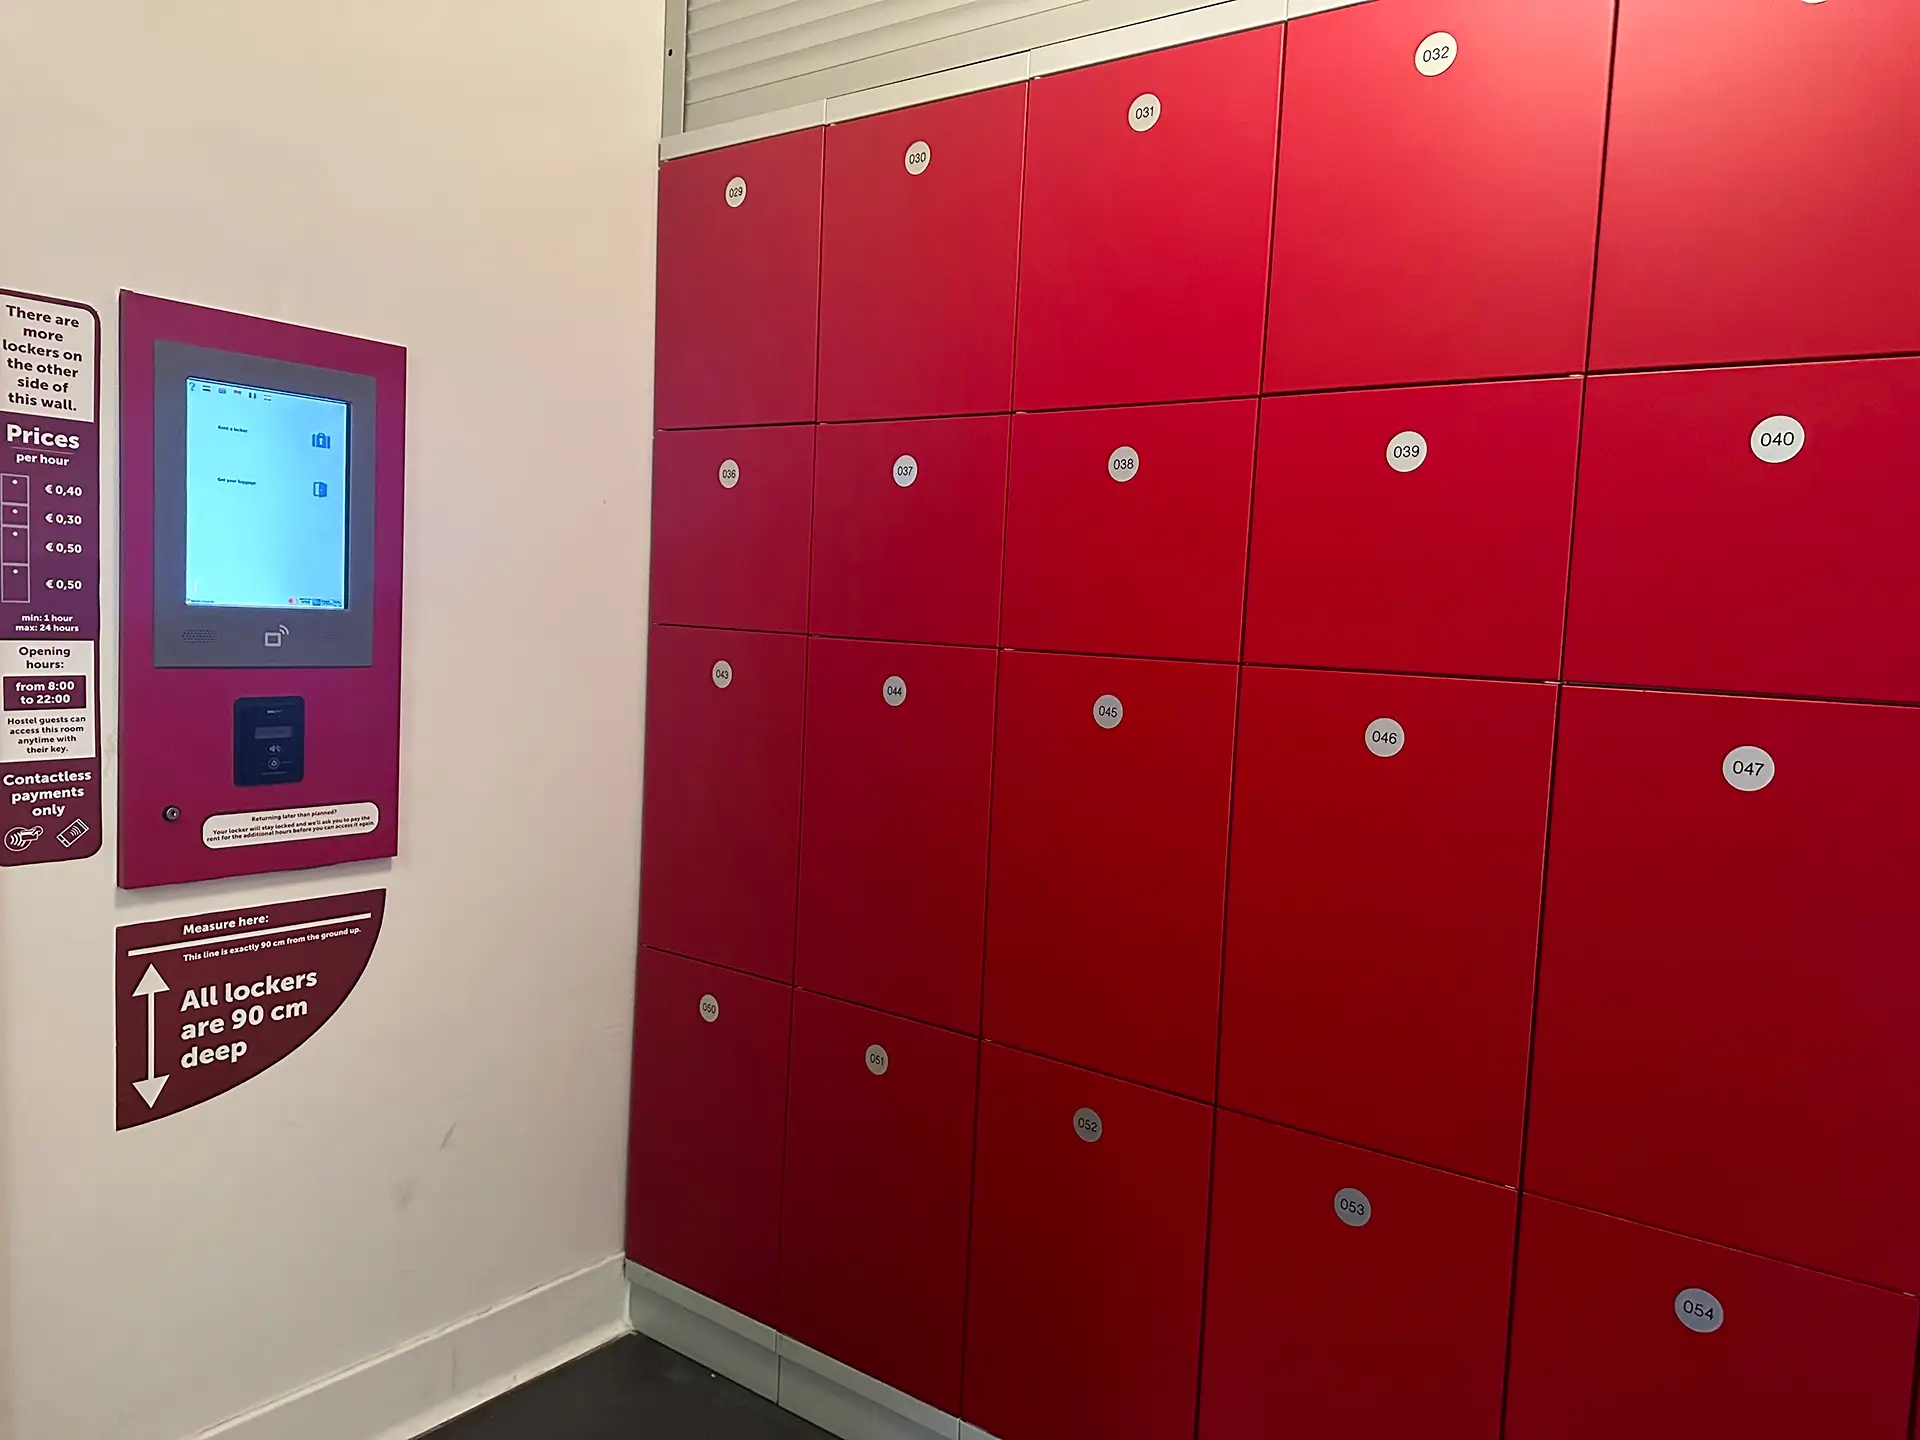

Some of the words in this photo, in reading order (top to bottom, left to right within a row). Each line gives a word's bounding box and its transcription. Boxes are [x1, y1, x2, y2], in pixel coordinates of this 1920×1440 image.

[1422, 45, 1450, 63] 032
[1135, 105, 1154, 120] 031
[909, 151, 927, 165] 030
[728, 186, 743, 199] 029
[6, 304, 52, 322] There
[55, 316, 80, 328] are
[23, 328, 64, 342] more
[2, 339, 59, 358] lockers
[63, 352, 82, 362] on
[7, 358, 32, 371] the
[36, 364, 78, 378] other
[18, 377, 48, 390] side
[52, 383, 68, 392] of
[8, 392, 37, 406] this
[41, 398, 77, 411] wall.
[6, 424, 80, 449] Prices
[1760, 431, 1795, 447] 040
[1393, 444, 1420, 459] 039
[16, 453, 37, 464] per
[40, 454, 69, 466] hour
[1113, 458, 1134, 471] 038
[722, 469, 737, 479] 036
[897, 465, 914, 477] 037
[55, 485, 82, 497] 0,40
[56, 514, 82, 525] 0,30
[56, 543, 82, 554] 0,50
[56, 580, 82, 590] 0,50
[51, 614, 73, 622] hour
[53, 624, 79, 632] hours
[19, 646, 70, 658] Opening
[26, 660, 64, 669] hours:
[715, 669, 729, 680] 043
[16, 682, 45, 691] from
[48, 681, 74, 690] 8:00
[886, 685, 902, 696] 044
[20, 695, 34, 704] to
[36, 694, 70, 704] 22:00
[1098, 705, 1118, 718] 045
[39, 716, 68, 725] guests
[18, 737, 54, 745] anytime
[1371, 730, 1398, 745] 046
[1732, 760, 1765, 777] 047
[3, 770, 92, 786] Contactless
[12, 787, 84, 804] payments
[32, 804, 66, 817] only
[312, 809, 337, 817] planned?
[183, 921, 236, 936] Measure
[238, 915, 269, 927] here:
[183, 953, 202, 962] This
[203, 949, 220, 959] line
[230, 943, 259, 955] exactly
[260, 940, 272, 949] 90
[273, 939, 285, 947] cm
[286, 936, 306, 945] from
[320, 928, 348, 940] ground
[180, 985, 218, 1012] All
[225, 972, 318, 1003] lockers
[702, 1002, 717, 1015] 050
[180, 1017, 224, 1040] are
[232, 1005, 264, 1030] 90
[270, 1000, 308, 1021] cm
[180, 1041, 248, 1068] deep
[869, 1053, 884, 1066] 051
[1077, 1117, 1098, 1133] 052
[1339, 1198, 1365, 1216] 053
[1683, 1299, 1714, 1321] 054
